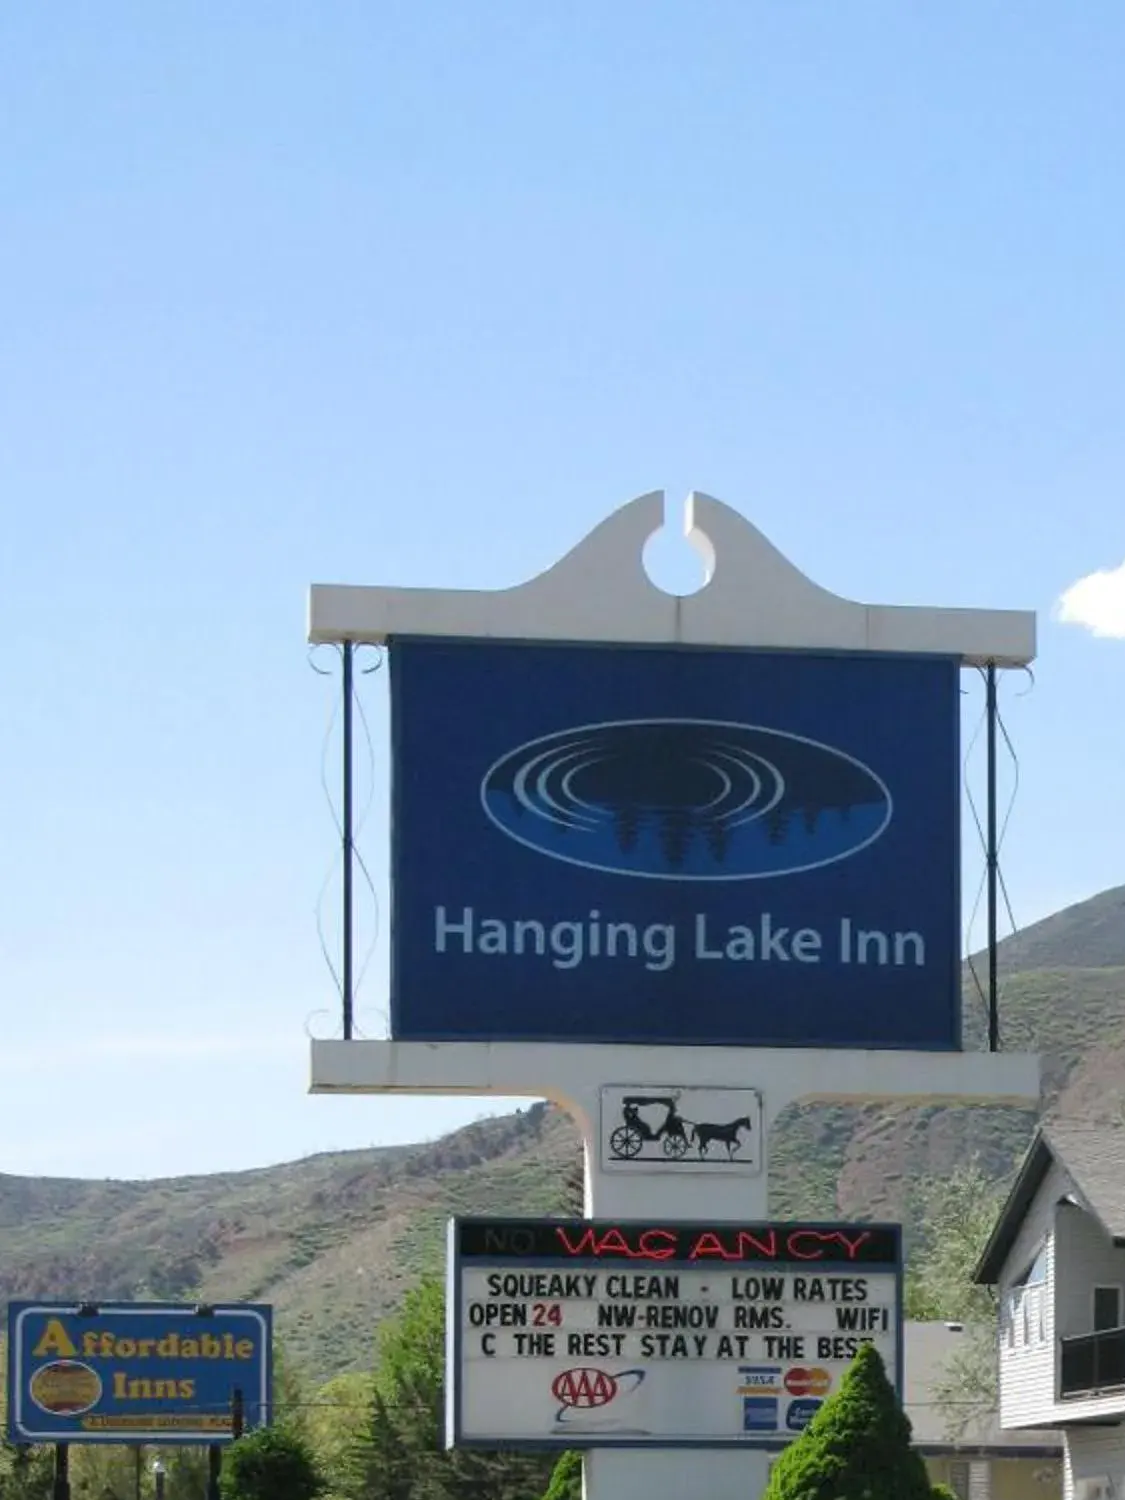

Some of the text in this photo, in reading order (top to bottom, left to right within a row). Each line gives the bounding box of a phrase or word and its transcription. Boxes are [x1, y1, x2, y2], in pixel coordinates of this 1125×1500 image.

[434, 906, 926, 971] Hanging Lake Inn
[555, 1226, 871, 1263] VACANCY
[487, 1273, 597, 1298] SQUEAKY
[606, 1275, 679, 1299] CLEAN
[732, 1277, 784, 1300] LOW
[794, 1278, 868, 1301] RATES
[469, 1303, 889, 1331] OPEN 24 NW-RENOV RMS. WIFI
[32, 1317, 254, 1359] Affordable
[481, 1333, 496, 1356] C
[513, 1333, 555, 1356] THE
[568, 1333, 627, 1357] REST
[641, 1334, 707, 1357] STAY
[717, 1335, 749, 1358] AT
[764, 1336, 805, 1358] THE
[112, 1371, 196, 1400] Inns
[560, 1369, 610, 1405] AAA
